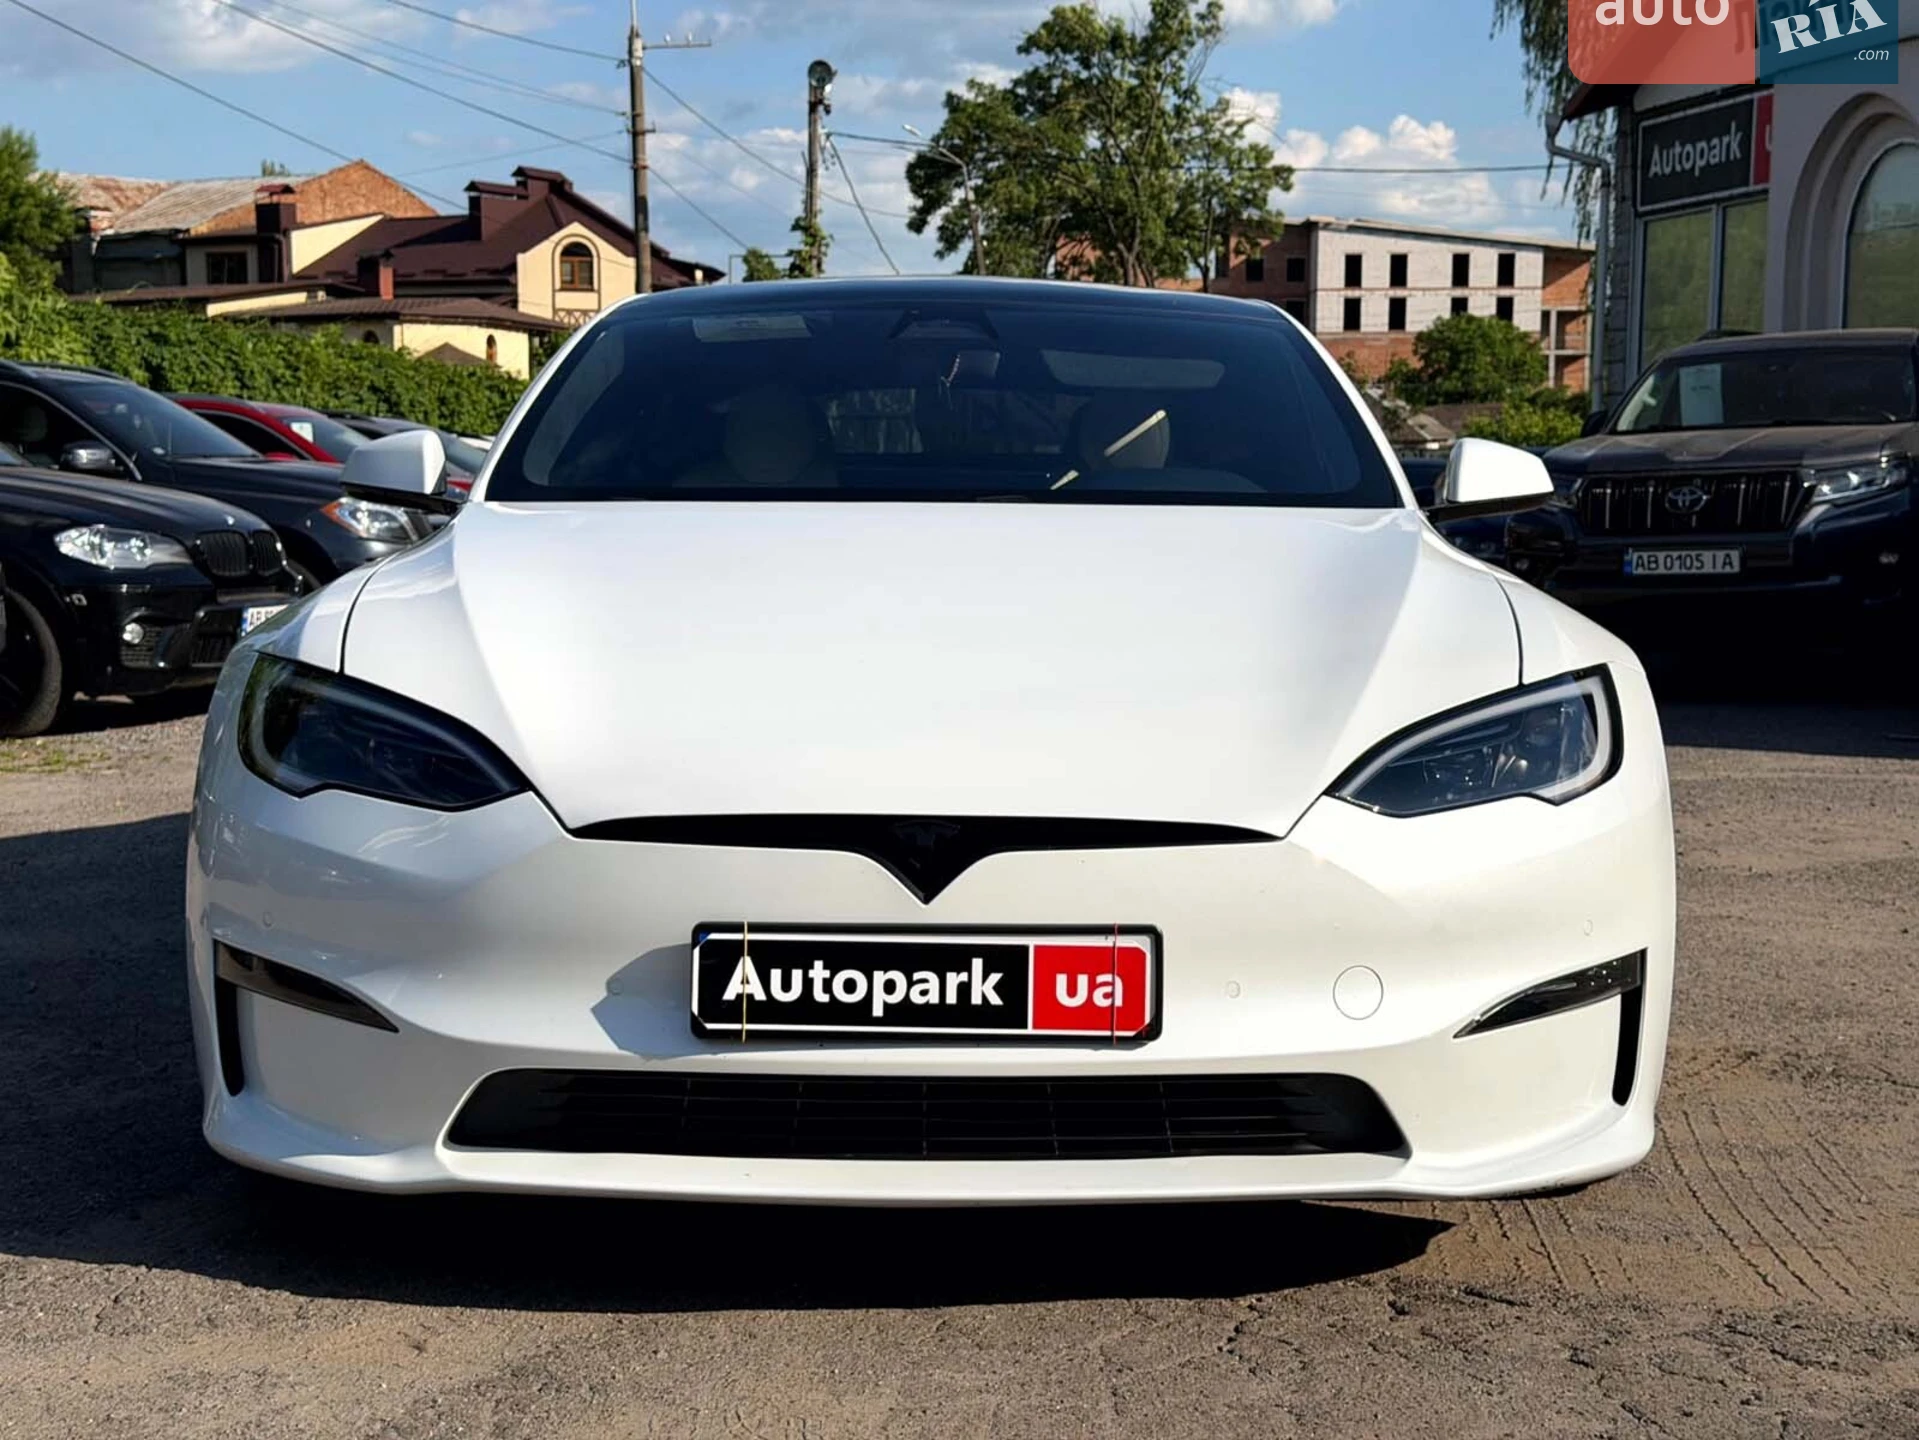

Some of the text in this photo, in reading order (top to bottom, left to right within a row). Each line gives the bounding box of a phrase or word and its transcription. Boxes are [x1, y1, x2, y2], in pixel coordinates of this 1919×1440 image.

[1648, 119, 1743, 178] Autopark
[1635, 553, 1659, 571] AB
[1663, 553, 1705, 571] 0105
[722, 956, 1123, 1018] Autopark ua
